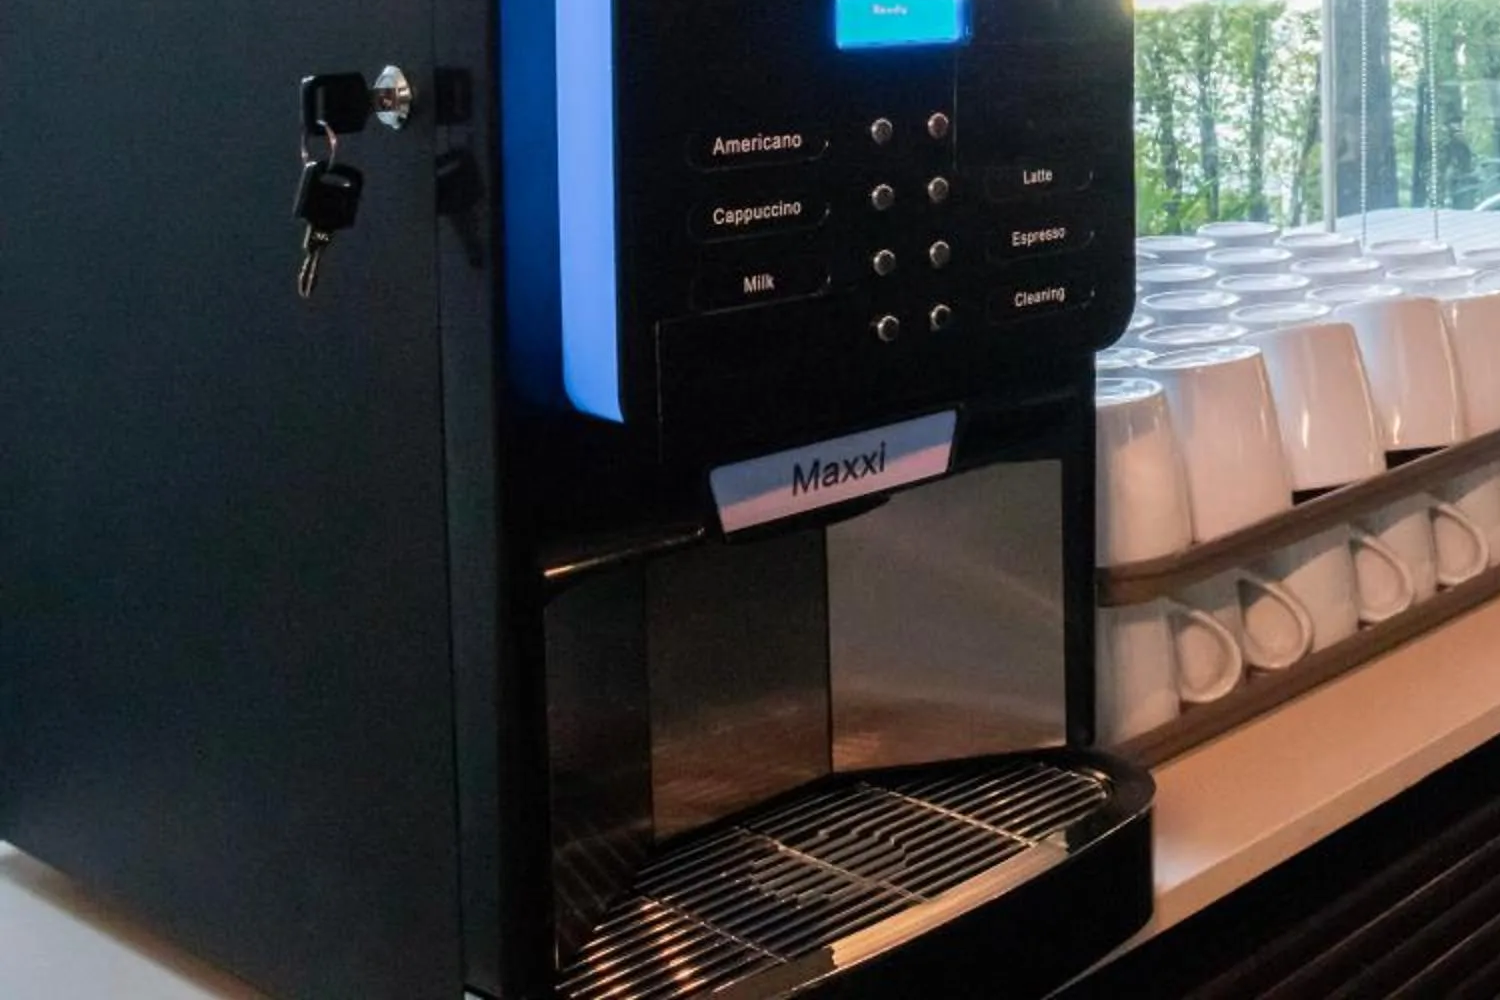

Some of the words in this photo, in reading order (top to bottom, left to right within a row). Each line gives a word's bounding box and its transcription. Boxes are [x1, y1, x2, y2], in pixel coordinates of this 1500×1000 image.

[712, 133, 802, 157] Americano
[1023, 168, 1053, 186] Latte
[712, 200, 802, 226] Cappuccino
[1011, 226, 1066, 248] Espresso
[743, 274, 775, 294] Milk
[1014, 285, 1066, 308] Cleaning
[791, 441, 887, 497] Maxxi
